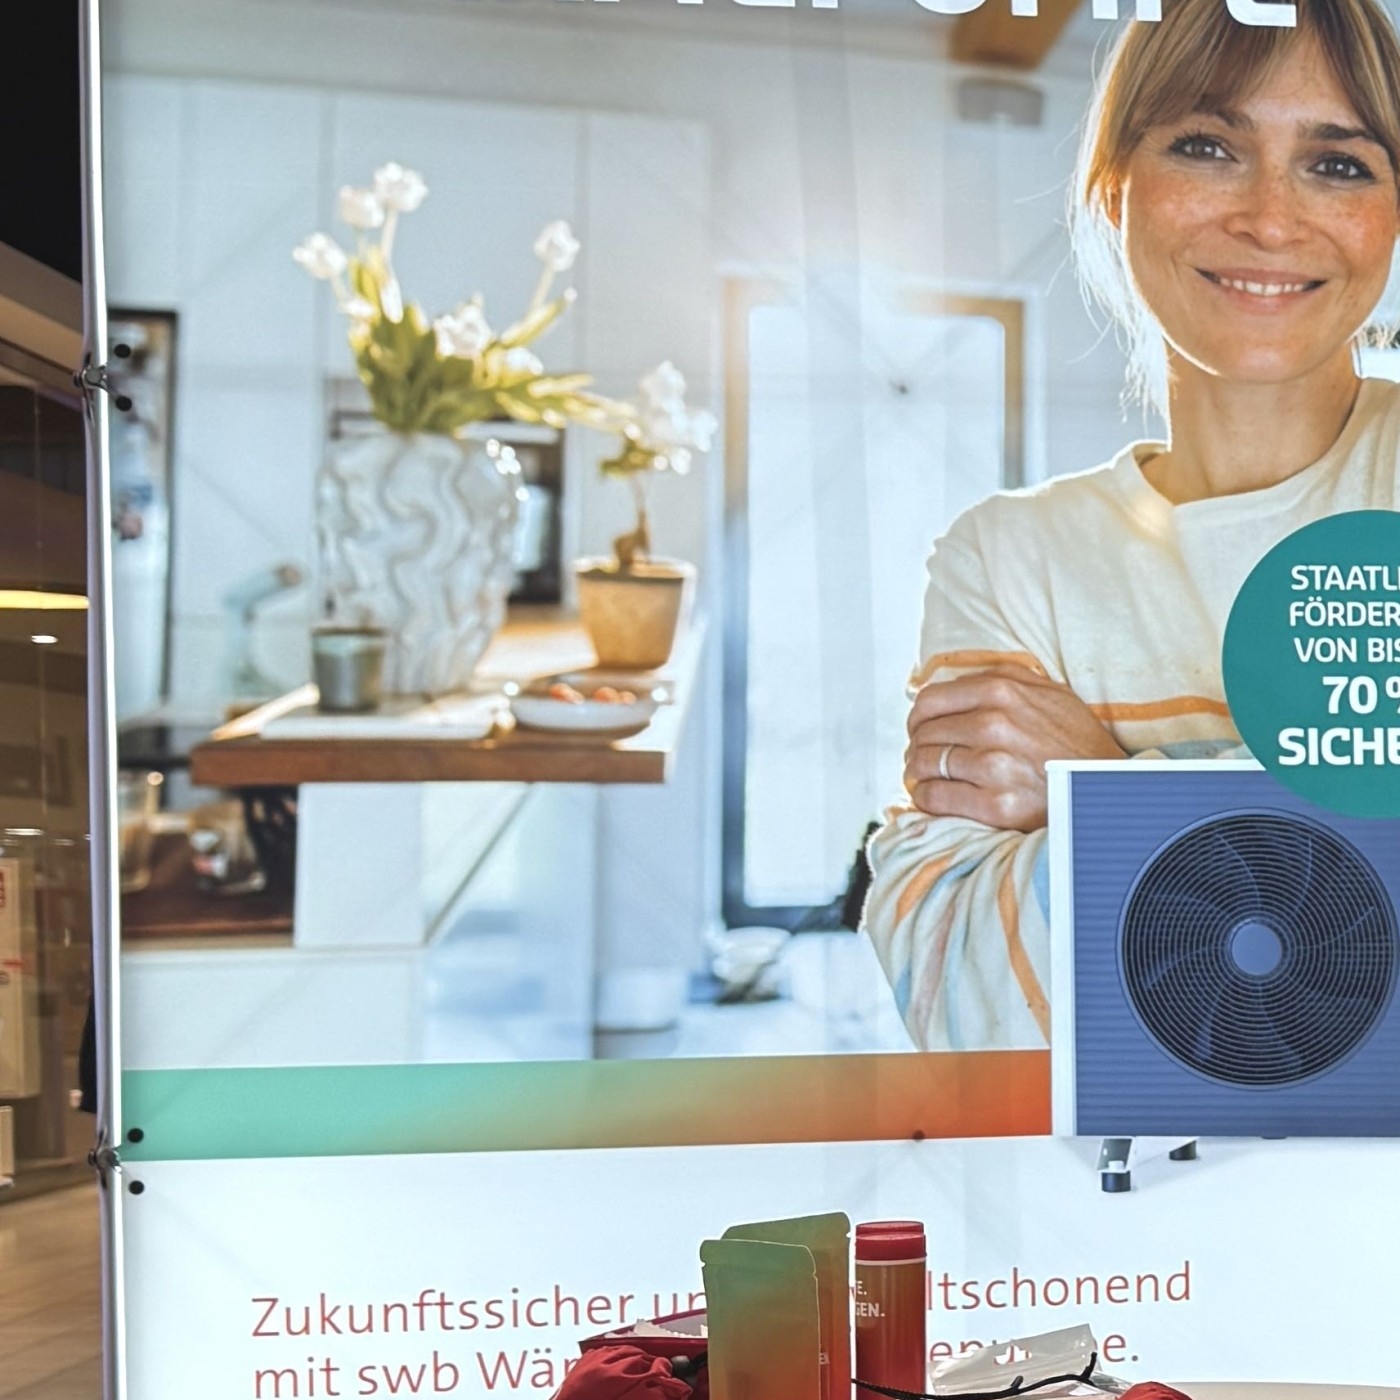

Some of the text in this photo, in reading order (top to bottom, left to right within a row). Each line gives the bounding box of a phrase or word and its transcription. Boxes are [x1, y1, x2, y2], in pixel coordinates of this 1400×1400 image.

[1293, 637, 1358, 663] VON
[251, 1284, 635, 1338] Zukunftssicher
[927, 1260, 1191, 1312] ltschonend
[254, 1346, 580, 1399] mit swb Wär
